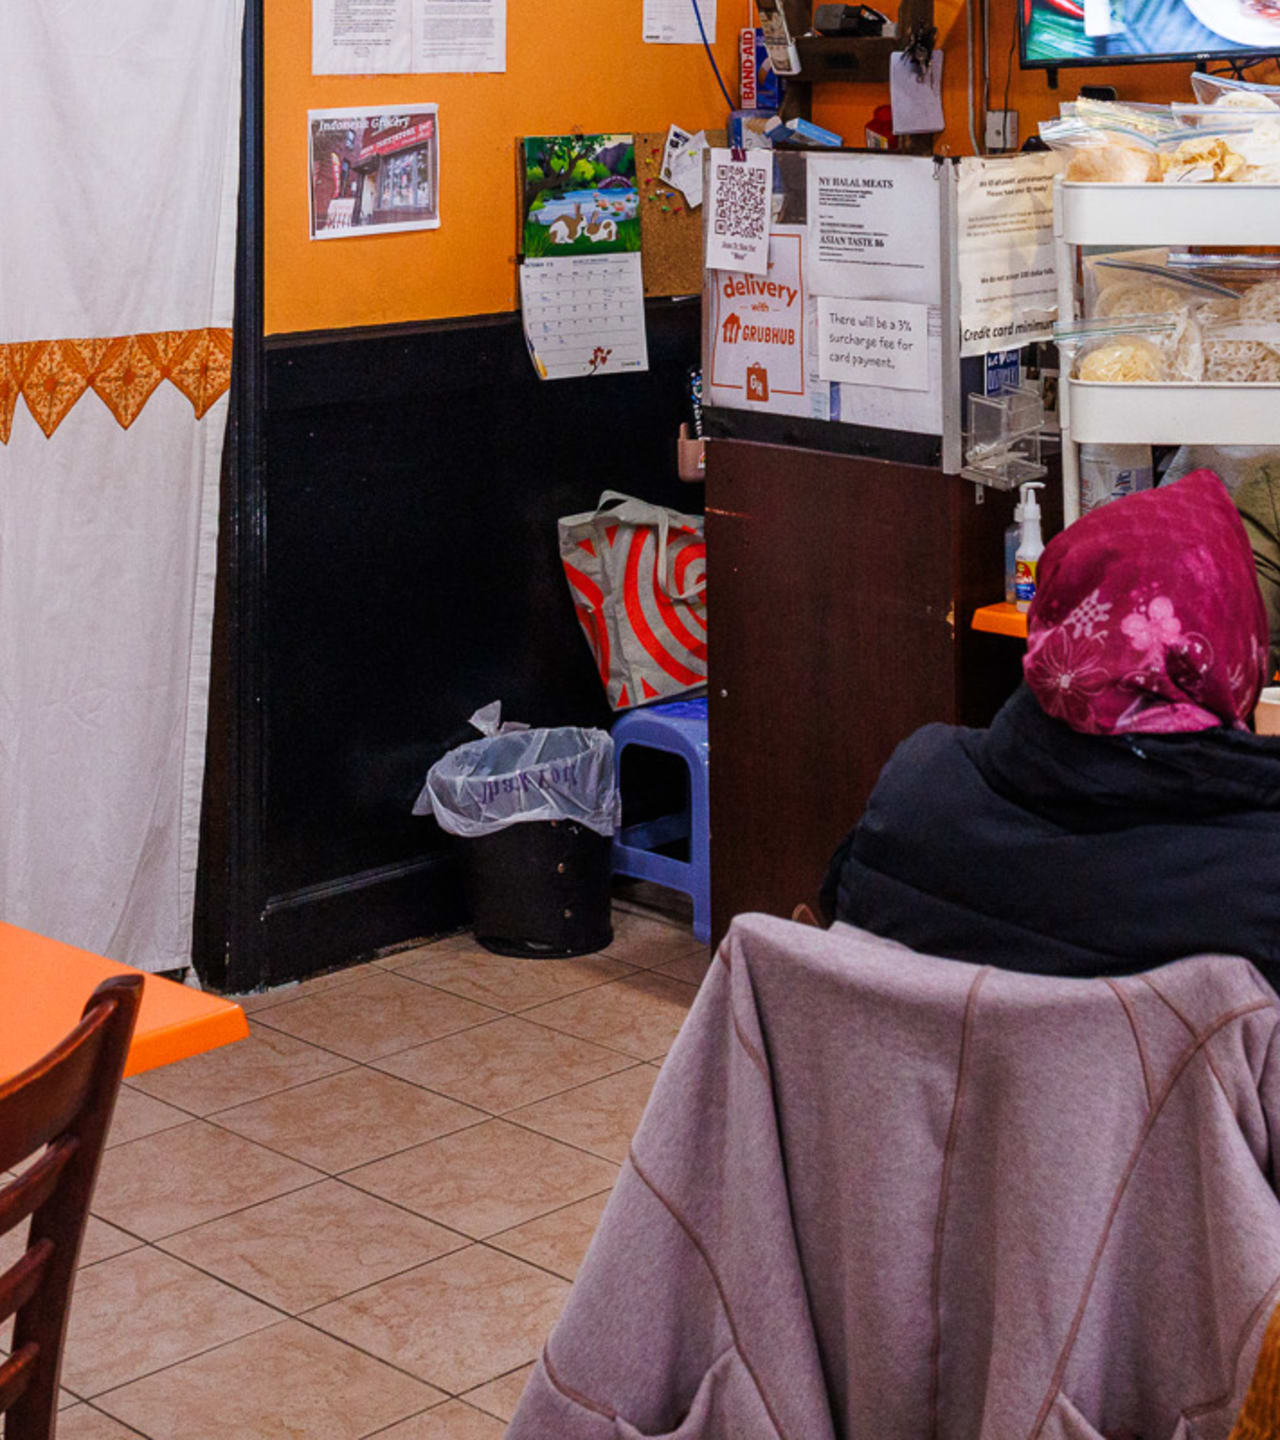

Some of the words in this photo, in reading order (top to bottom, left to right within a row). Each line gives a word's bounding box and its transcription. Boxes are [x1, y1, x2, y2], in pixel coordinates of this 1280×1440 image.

[742, 30, 755, 101] BAND-AID
[818, 176, 831, 186] NY
[832, 178, 861, 188] HALAL
[862, 179, 894, 189] MEATS
[819, 235, 846, 245] ASIAN
[848, 237, 874, 248] TASTE
[722, 272, 798, 308] delivery
[751, 302, 770, 313] with
[828, 312, 856, 327] There
[858, 315, 876, 327] will
[876, 316, 888, 329] be
[897, 319, 912, 332] 3%
[963, 324, 991, 343] Credit
[992, 320, 1015, 338] card
[741, 324, 796, 346] GRUBHUB
[828, 333, 877, 350] surcharge
[878, 335, 895, 350] fee
[897, 337, 914, 351] for
[828, 352, 851, 364] card
